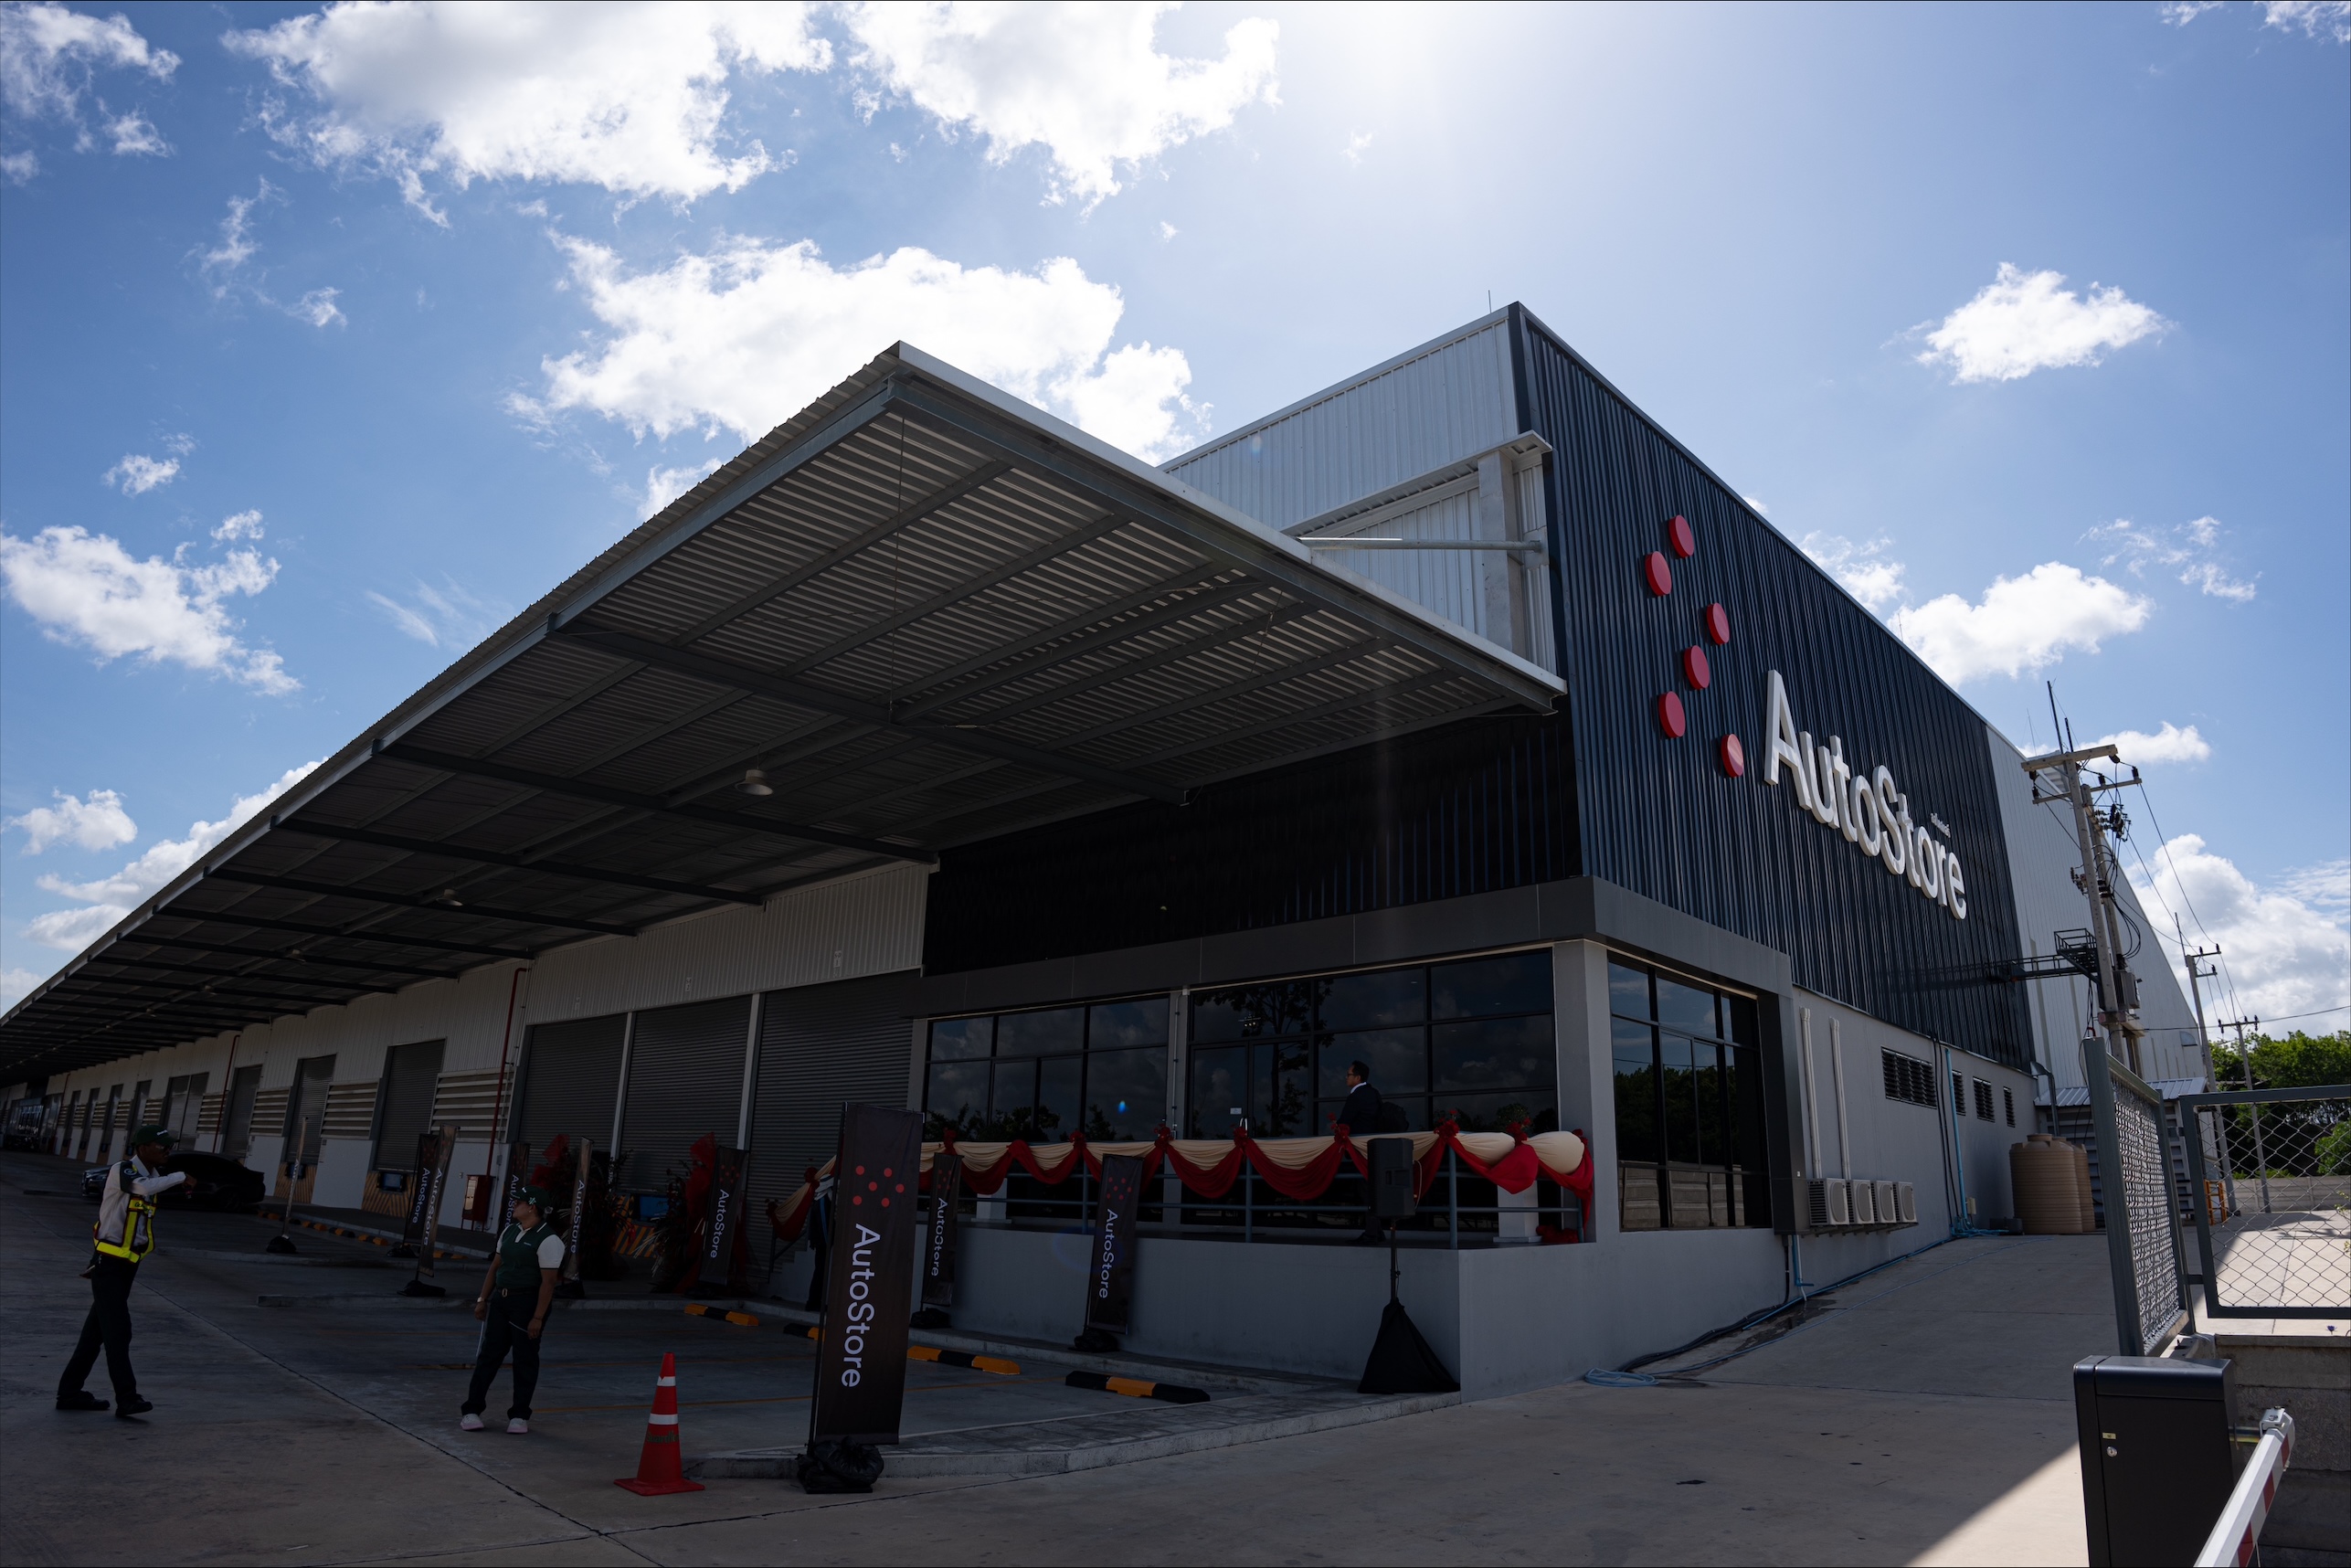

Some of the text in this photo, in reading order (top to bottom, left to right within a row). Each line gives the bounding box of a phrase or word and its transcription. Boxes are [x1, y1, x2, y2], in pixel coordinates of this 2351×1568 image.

[1763, 669, 1966, 920] AutoStore
[412, 1167, 430, 1224] AutoStore
[504, 1174, 520, 1228] AutStore
[570, 1180, 585, 1254] AutoStore
[710, 1189, 729, 1258] AutoStore
[1098, 1208, 1118, 1299] AutoStore
[841, 1223, 882, 1388] AutoStore
